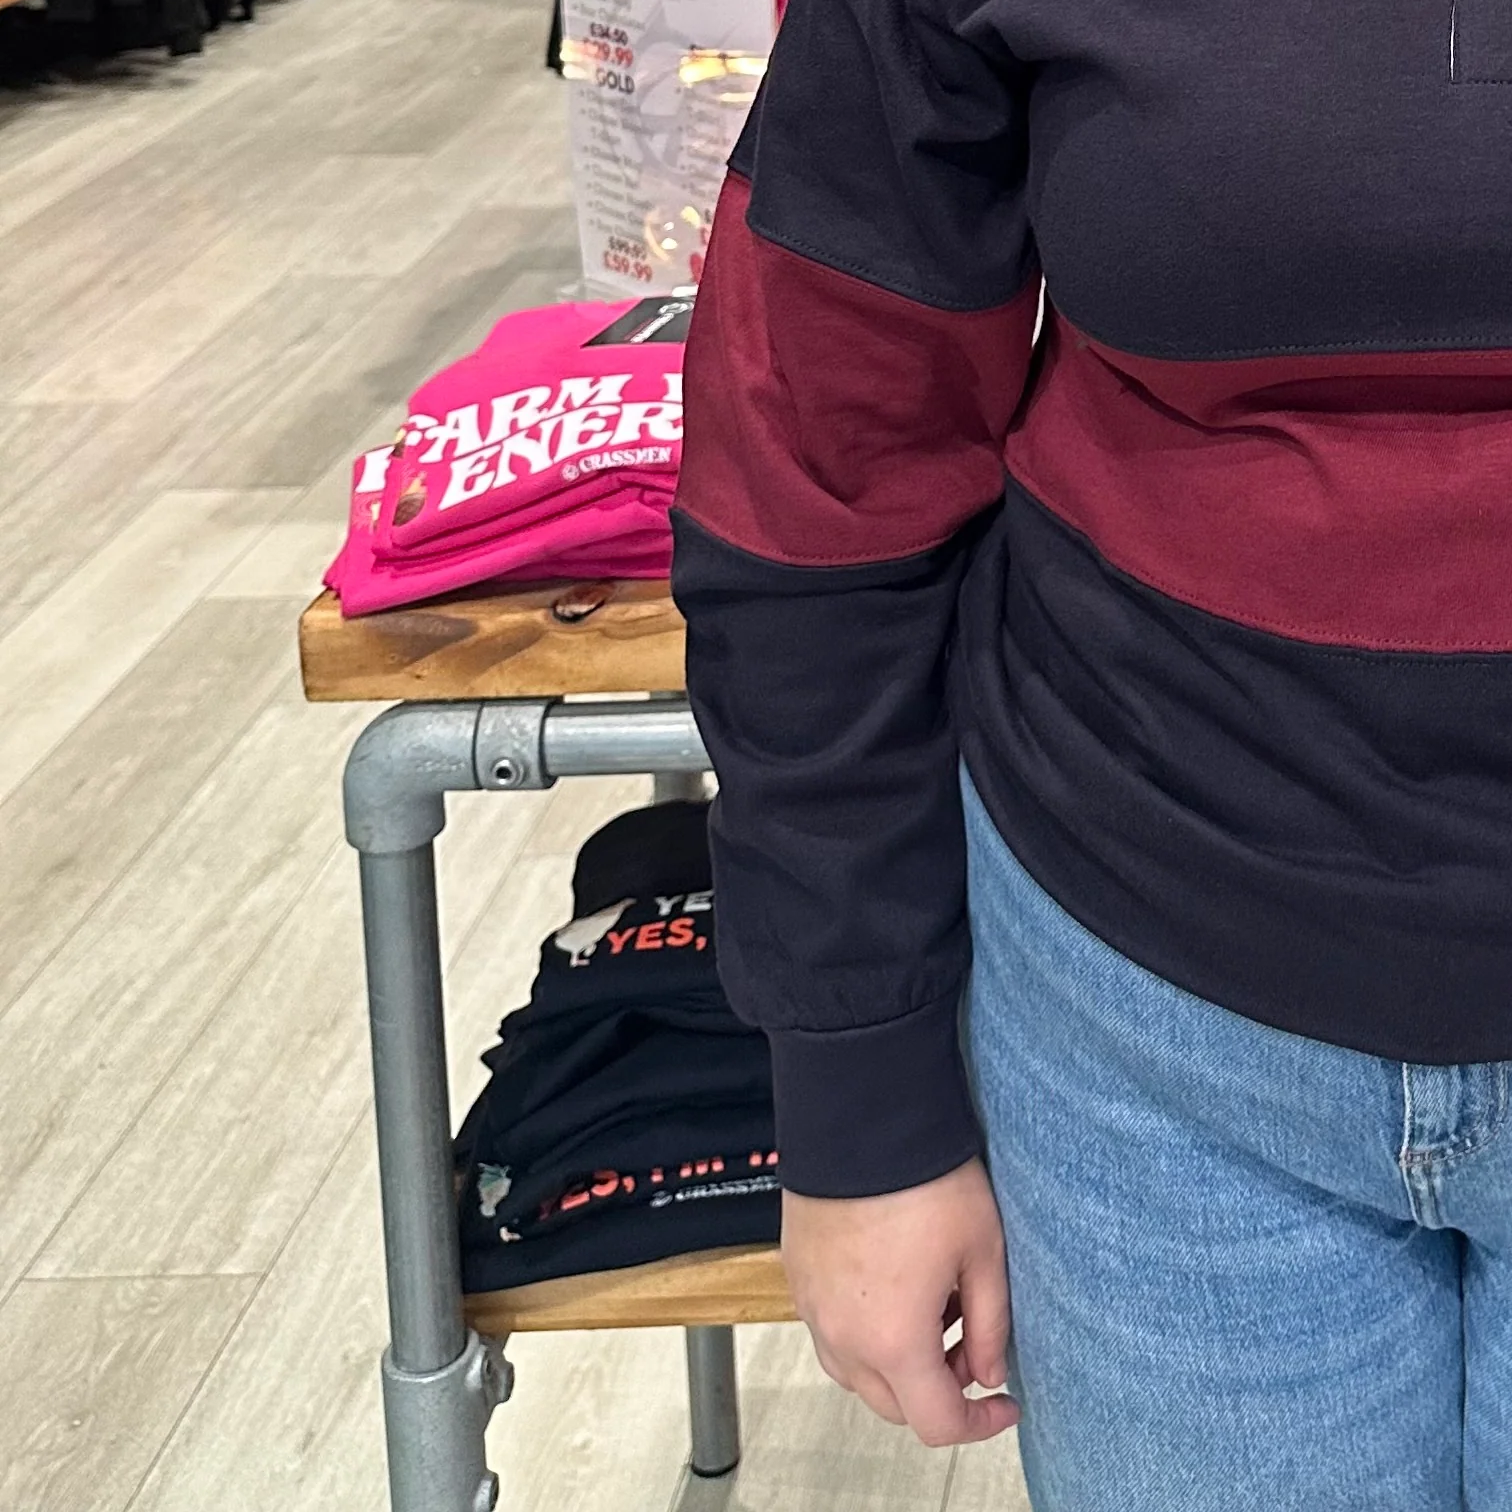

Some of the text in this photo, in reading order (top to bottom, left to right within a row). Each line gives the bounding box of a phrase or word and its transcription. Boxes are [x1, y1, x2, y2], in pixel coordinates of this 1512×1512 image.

[596, 67, 635, 95] GOLD
[579, 446, 673, 473] GRASSMEN
[607, 918, 708, 954] YES,
